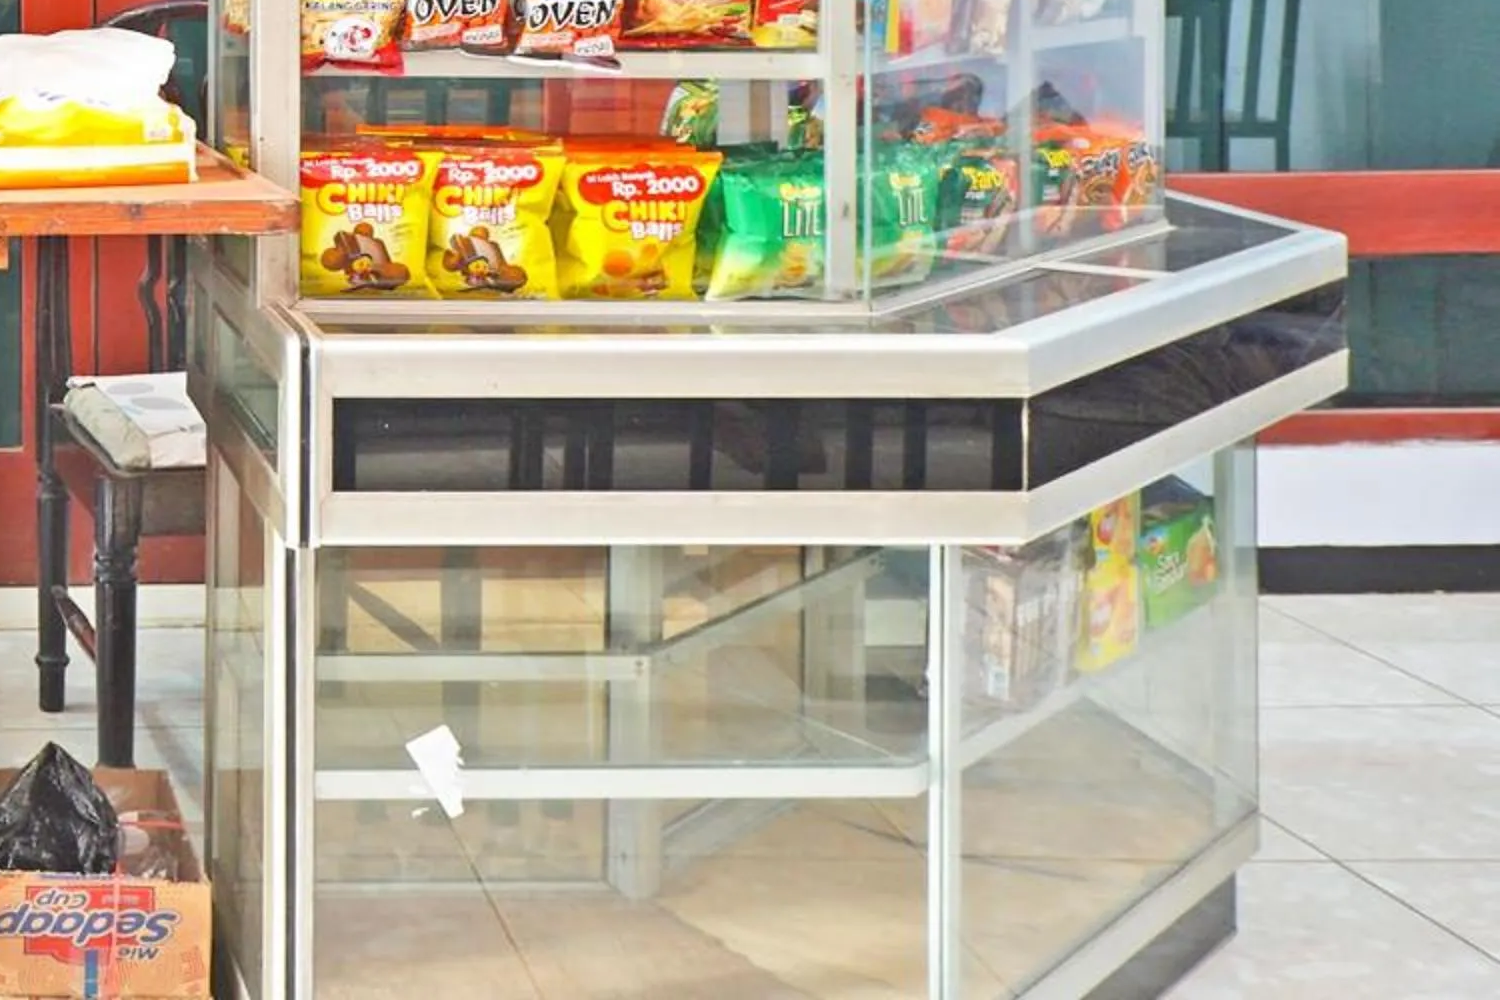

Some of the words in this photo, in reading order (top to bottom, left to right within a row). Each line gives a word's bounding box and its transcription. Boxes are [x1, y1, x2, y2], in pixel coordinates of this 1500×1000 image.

[530, 0, 615, 29] OVEN
[367, 160, 420, 179] 2000
[484, 164, 538, 184] 2000
[612, 182, 642, 199] Rp.
[647, 176, 700, 195] 2000
[347, 203, 404, 222] Balls
[601, 201, 685, 233] CHIKI
[631, 221, 683, 241] Balls
[37, 891, 85, 908] Cup
